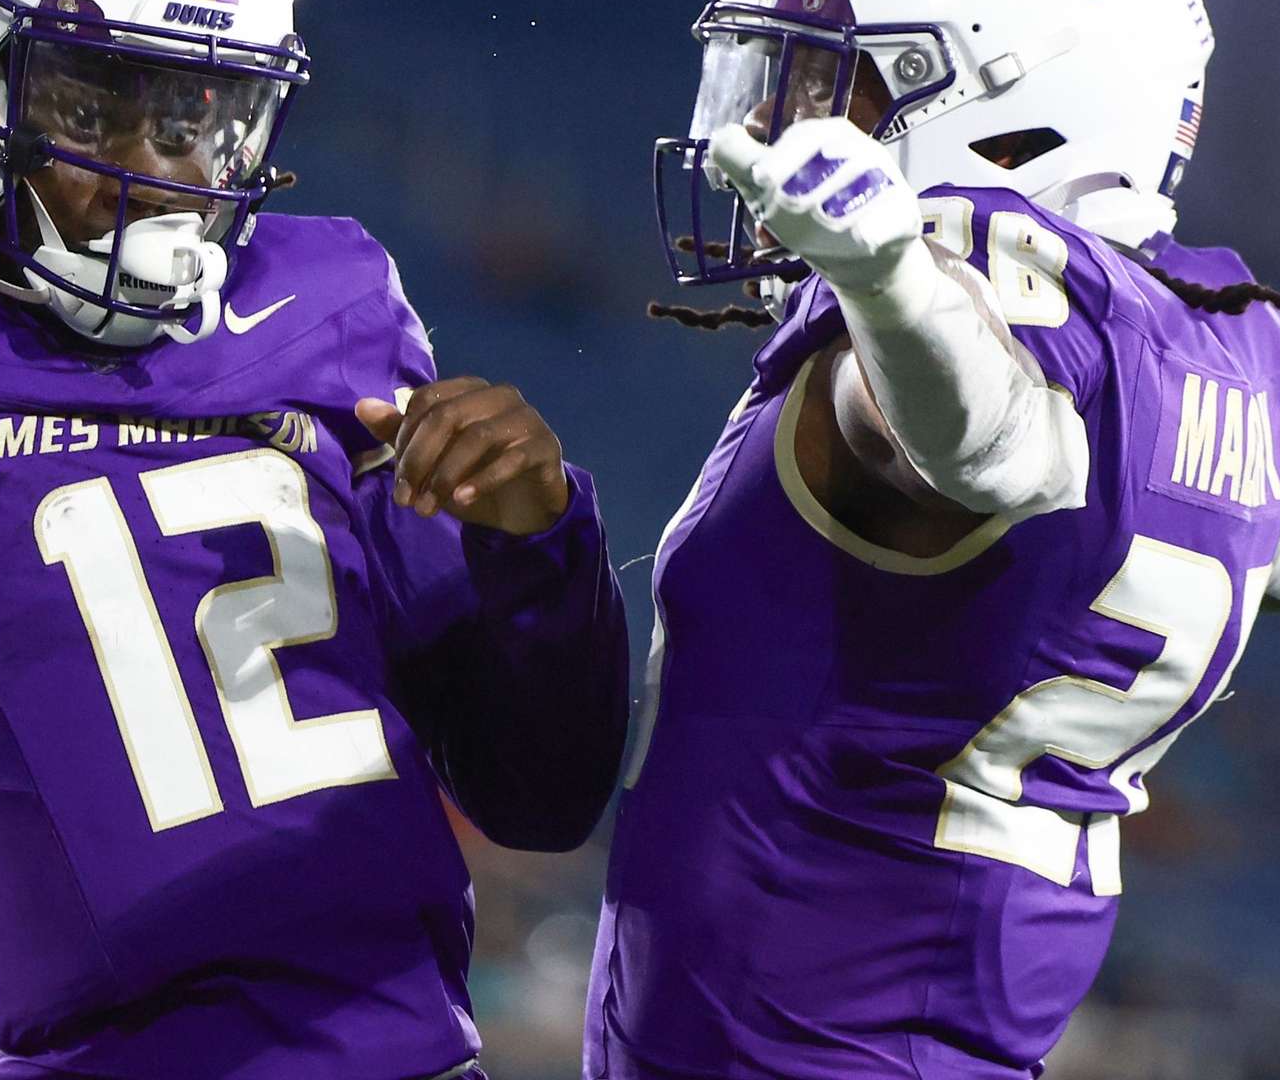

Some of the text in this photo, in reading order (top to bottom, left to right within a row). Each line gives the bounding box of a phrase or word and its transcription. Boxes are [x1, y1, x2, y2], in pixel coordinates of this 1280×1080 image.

[163, 2, 235, 30] DUKES
[918, 195, 1069, 328] 8
[34, 448, 398, 833] 12
